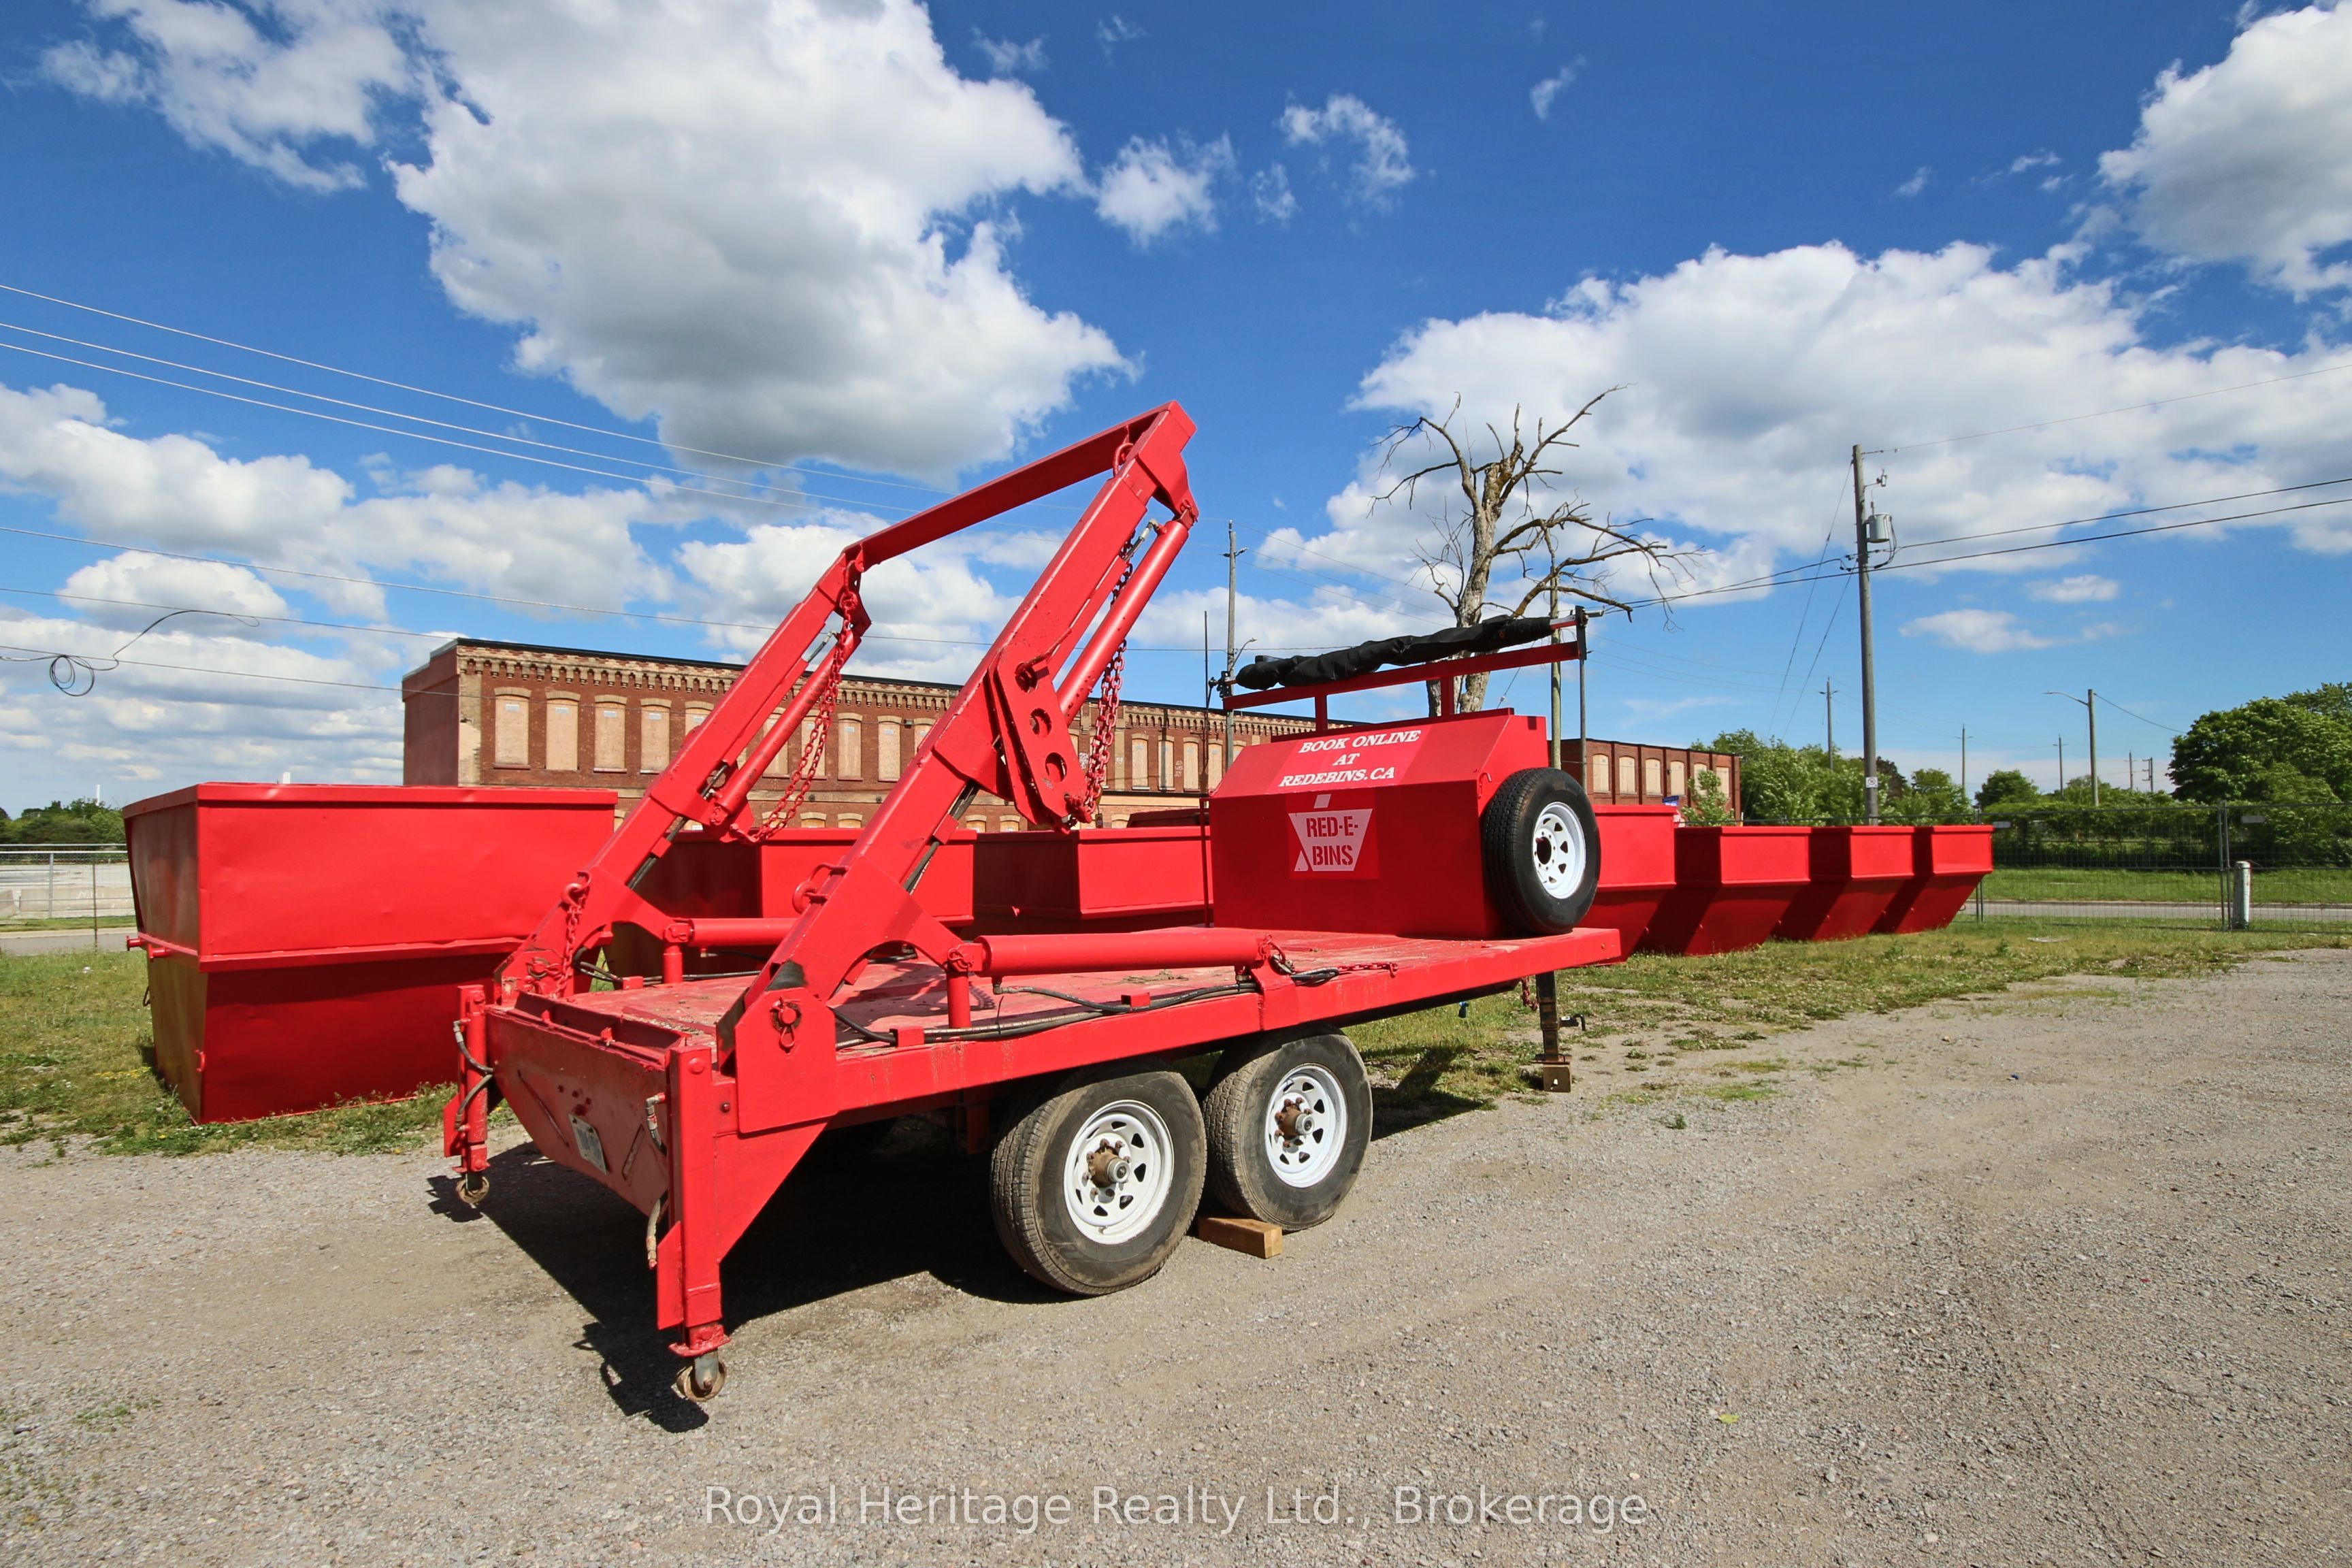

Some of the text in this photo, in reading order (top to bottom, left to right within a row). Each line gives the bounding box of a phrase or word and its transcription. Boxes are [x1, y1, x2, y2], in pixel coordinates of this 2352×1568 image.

[1298, 730, 1422, 753] BOOK ONLINE
[1333, 753, 1360, 766] AT
[1278, 766, 1395, 787] REDEBINS.CA
[1312, 845, 1354, 866] BINS
